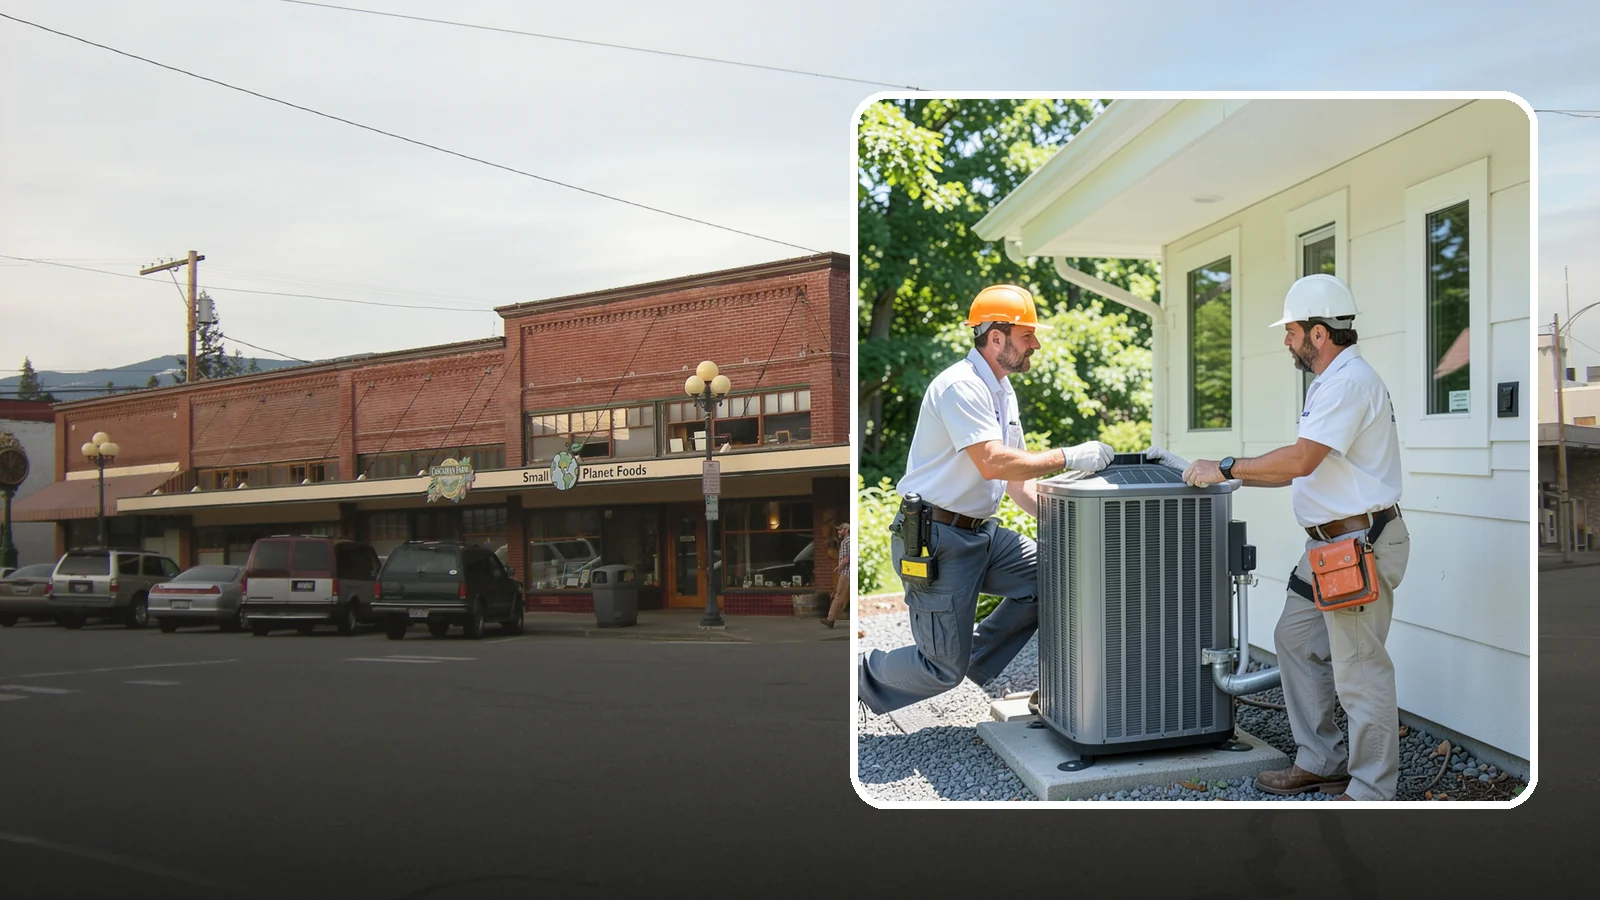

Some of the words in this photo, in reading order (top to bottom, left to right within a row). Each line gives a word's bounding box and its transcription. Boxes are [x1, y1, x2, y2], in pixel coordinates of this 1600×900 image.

[523, 470, 549, 483] Small
[583, 467, 614, 479] Planet
[617, 464, 647, 477] Foods
